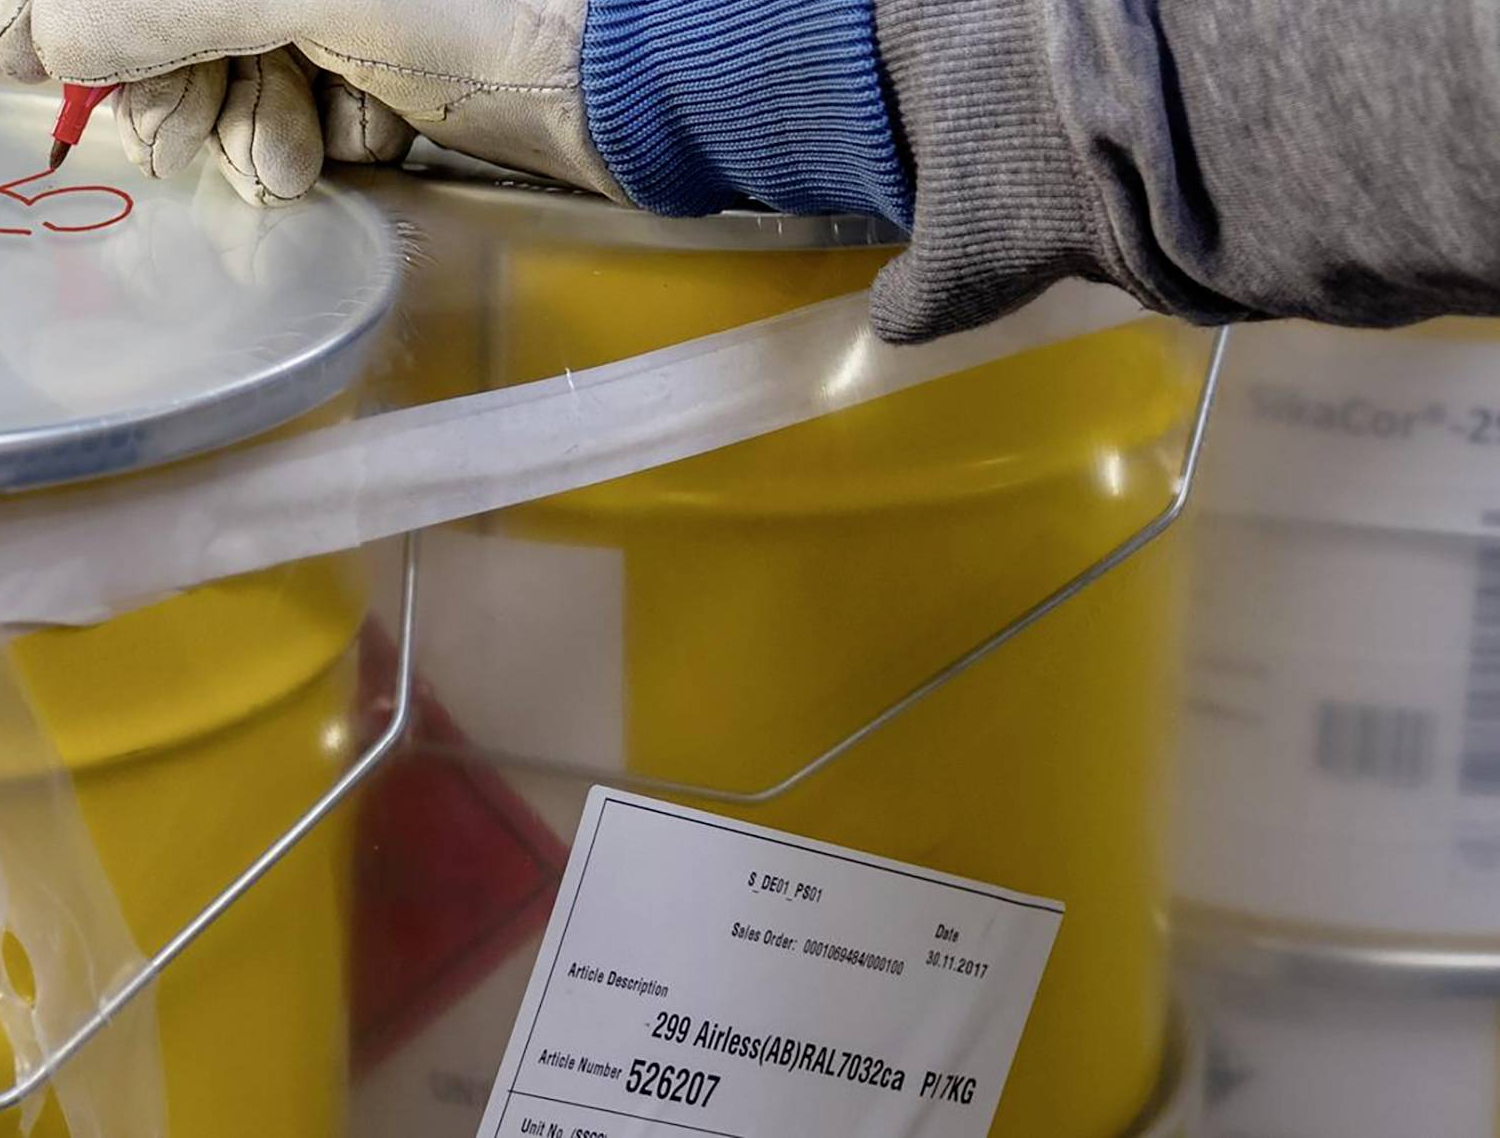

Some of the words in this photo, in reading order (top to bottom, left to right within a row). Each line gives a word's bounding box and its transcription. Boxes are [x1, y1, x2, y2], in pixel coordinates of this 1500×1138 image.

[731, 922, 761, 942] Sales
[763, 929, 798, 951] Order:
[934, 924, 959, 943] Date
[925, 950, 989, 979] 30.11.2017
[567, 962, 604, 983] Article
[606, 971, 669, 997] Description
[693, 1020, 906, 1092] Airless(AB)RAL7032ca
[538, 1049, 575, 1070] Article
[577, 1057, 622, 1080] Number
[625, 1058, 721, 1108] 526207
[521, 1117, 546, 1137] Unit
